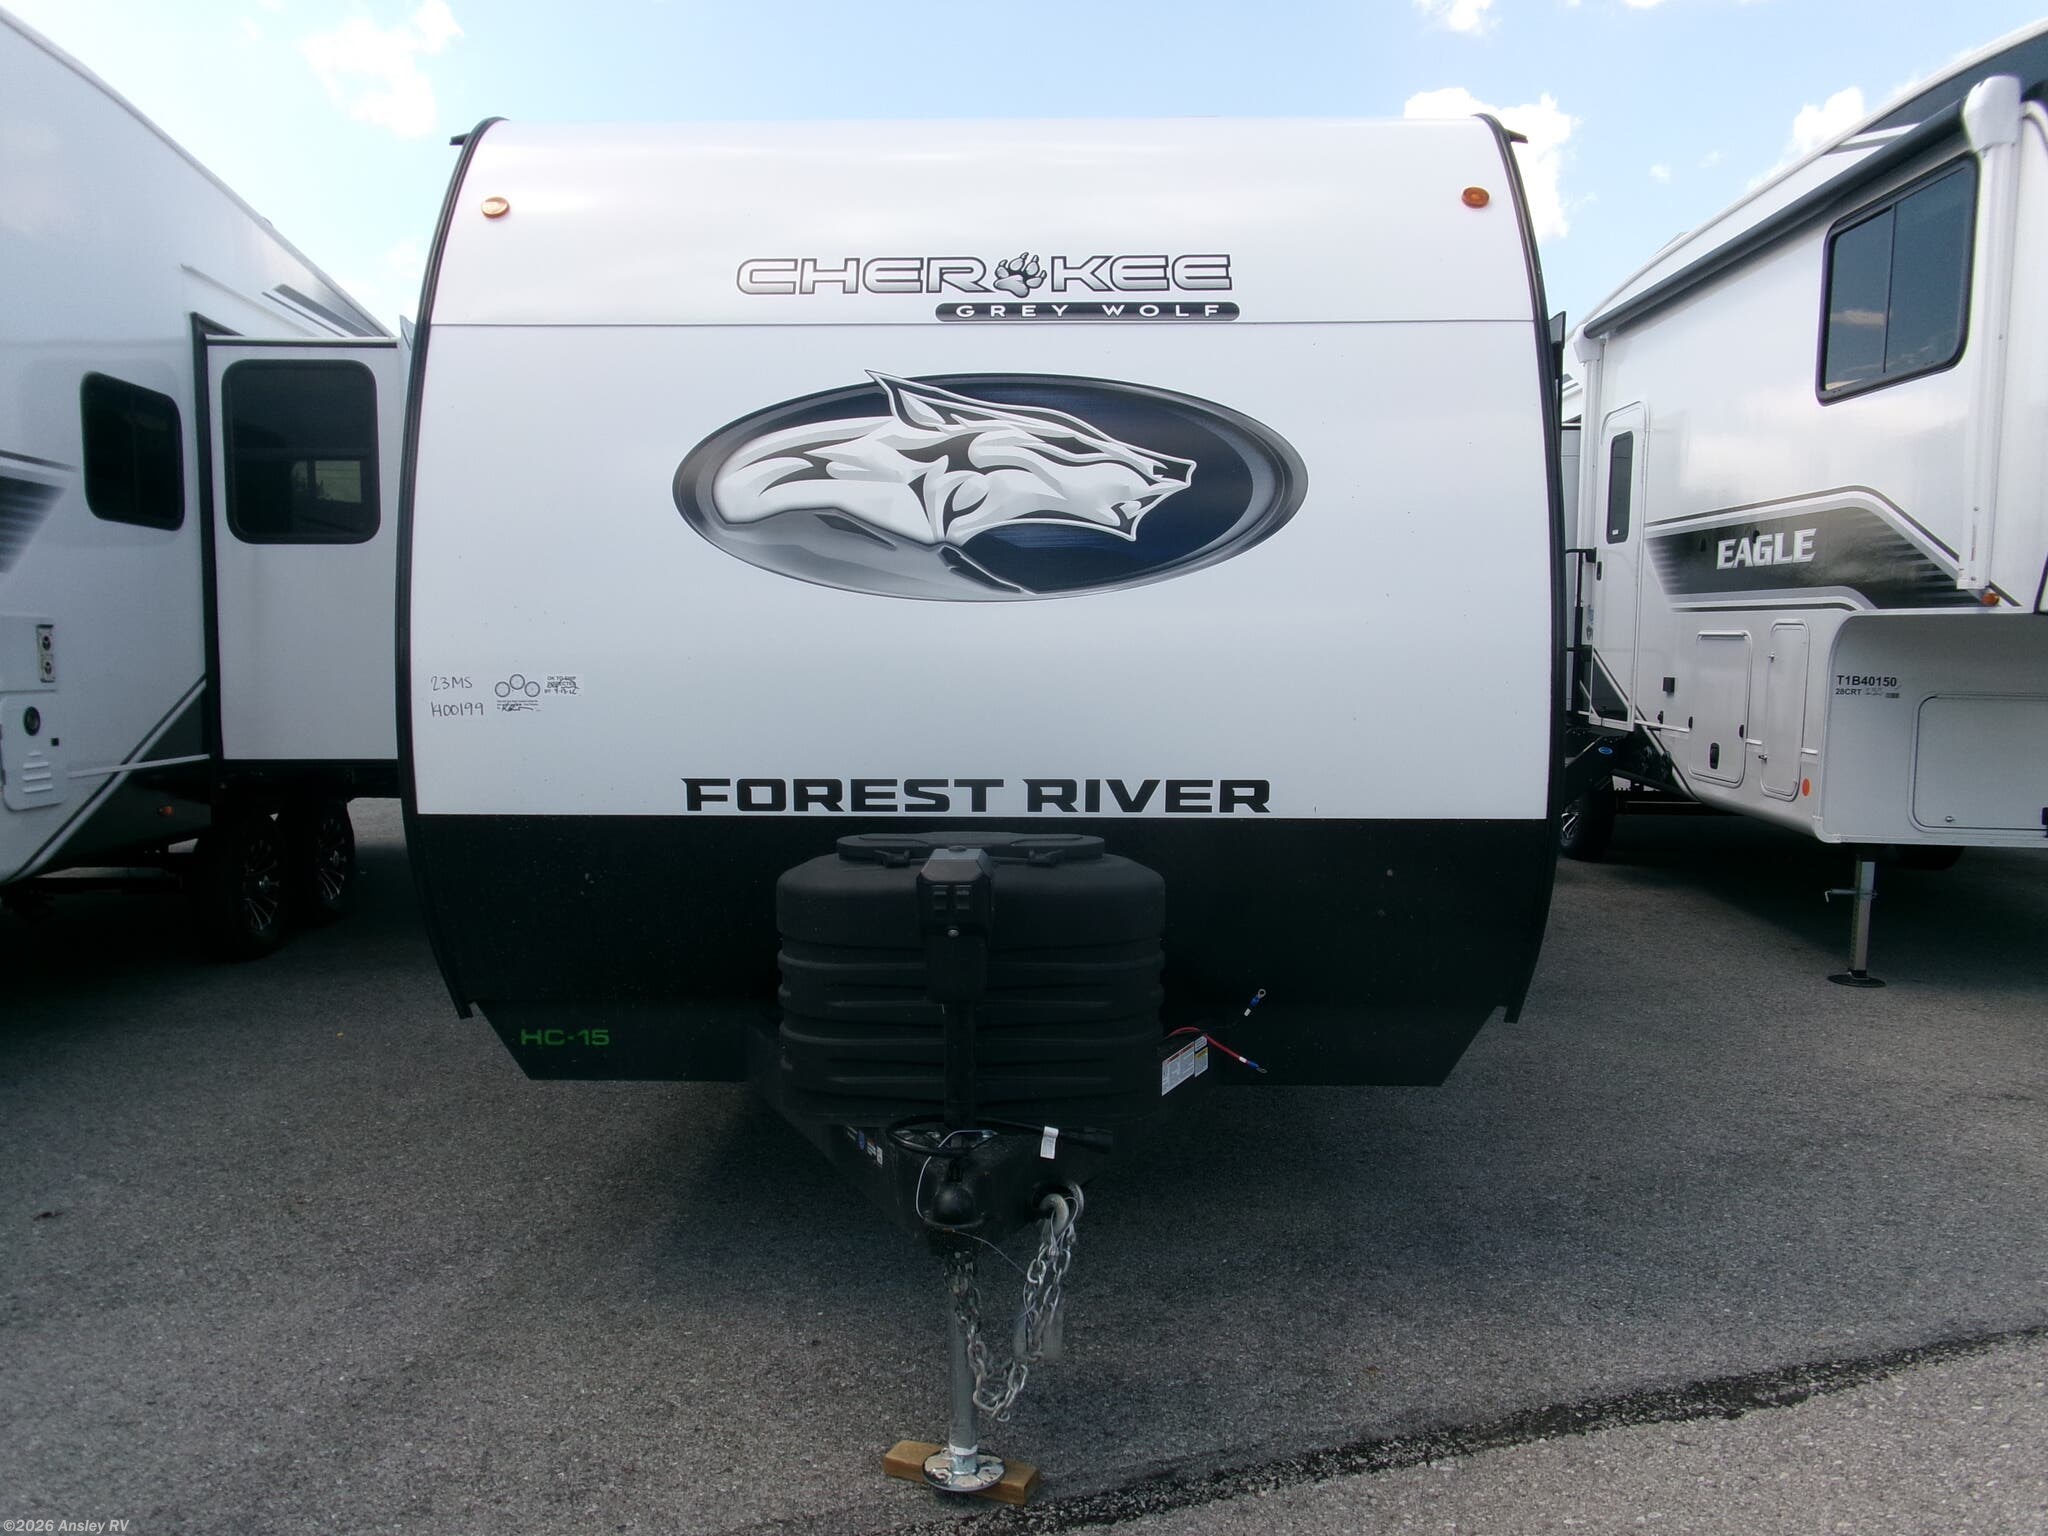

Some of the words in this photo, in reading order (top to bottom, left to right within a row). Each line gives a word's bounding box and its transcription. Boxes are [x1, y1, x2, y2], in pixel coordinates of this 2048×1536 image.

[955, 304, 1068, 318] GREY
[1102, 304, 1220, 318] WOLF
[1716, 528, 1817, 570] EAGLE
[430, 675, 473, 692] 23MS
[1836, 675, 1897, 687] T1B40150
[680, 778, 1004, 812] FOREST
[1022, 778, 1271, 813] RIVER
[521, 1029, 610, 1045] HC-15
